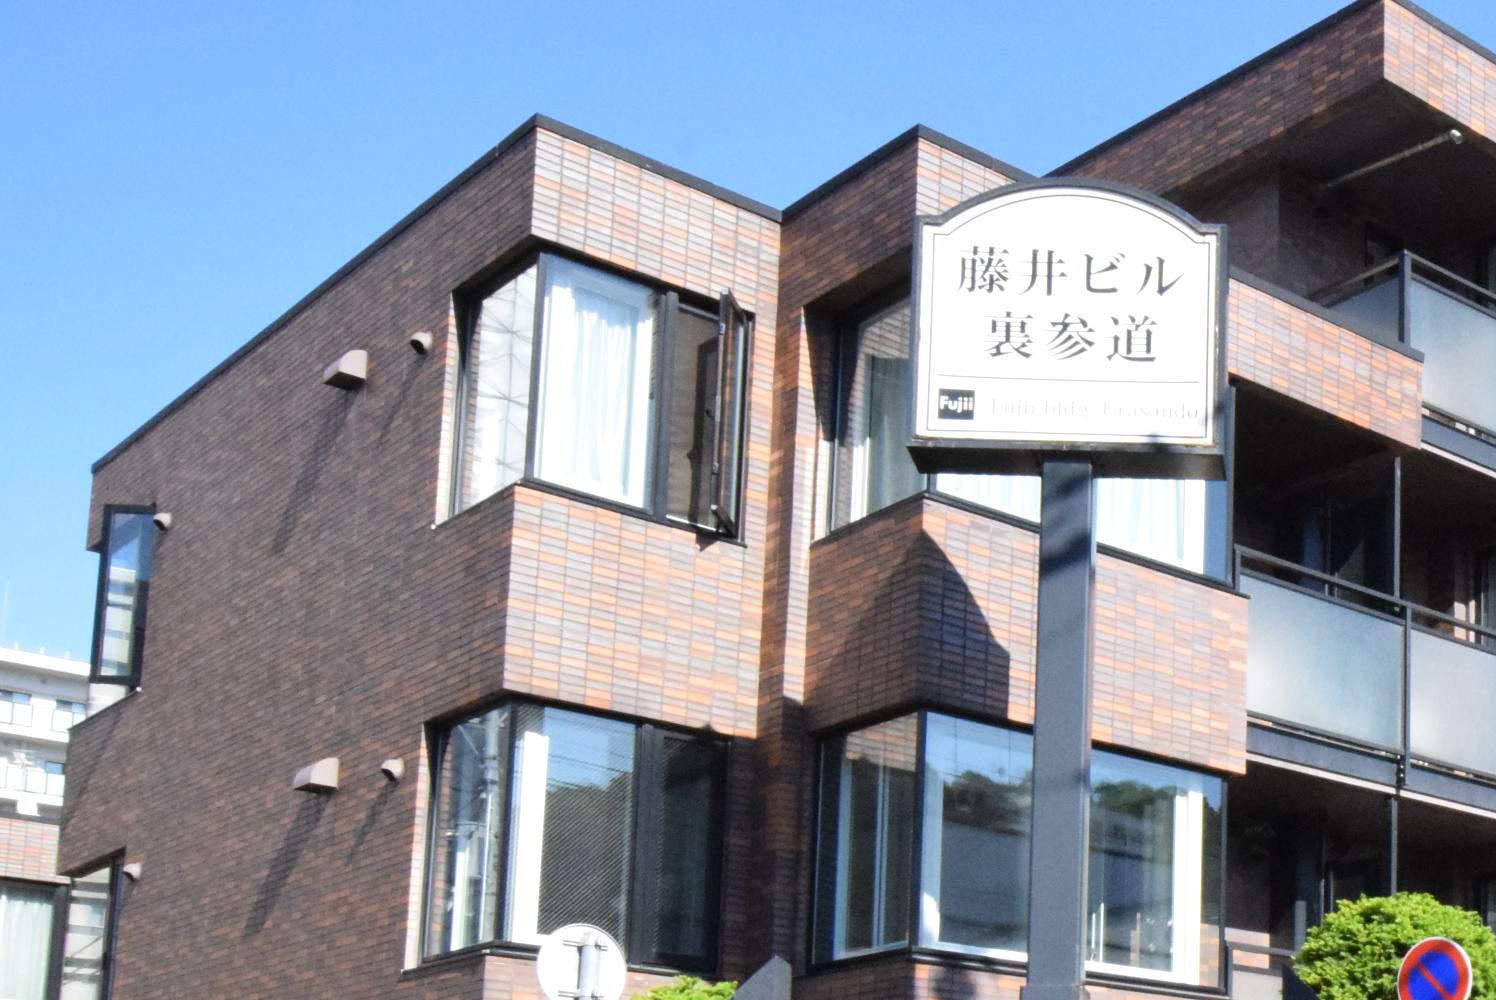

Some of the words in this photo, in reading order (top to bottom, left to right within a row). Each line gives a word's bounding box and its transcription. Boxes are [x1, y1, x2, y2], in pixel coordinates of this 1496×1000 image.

[957, 245, 1185, 297] 藤井ビル
[984, 310, 1158, 363] 裏参道
[940, 395, 974, 413] Fujii
